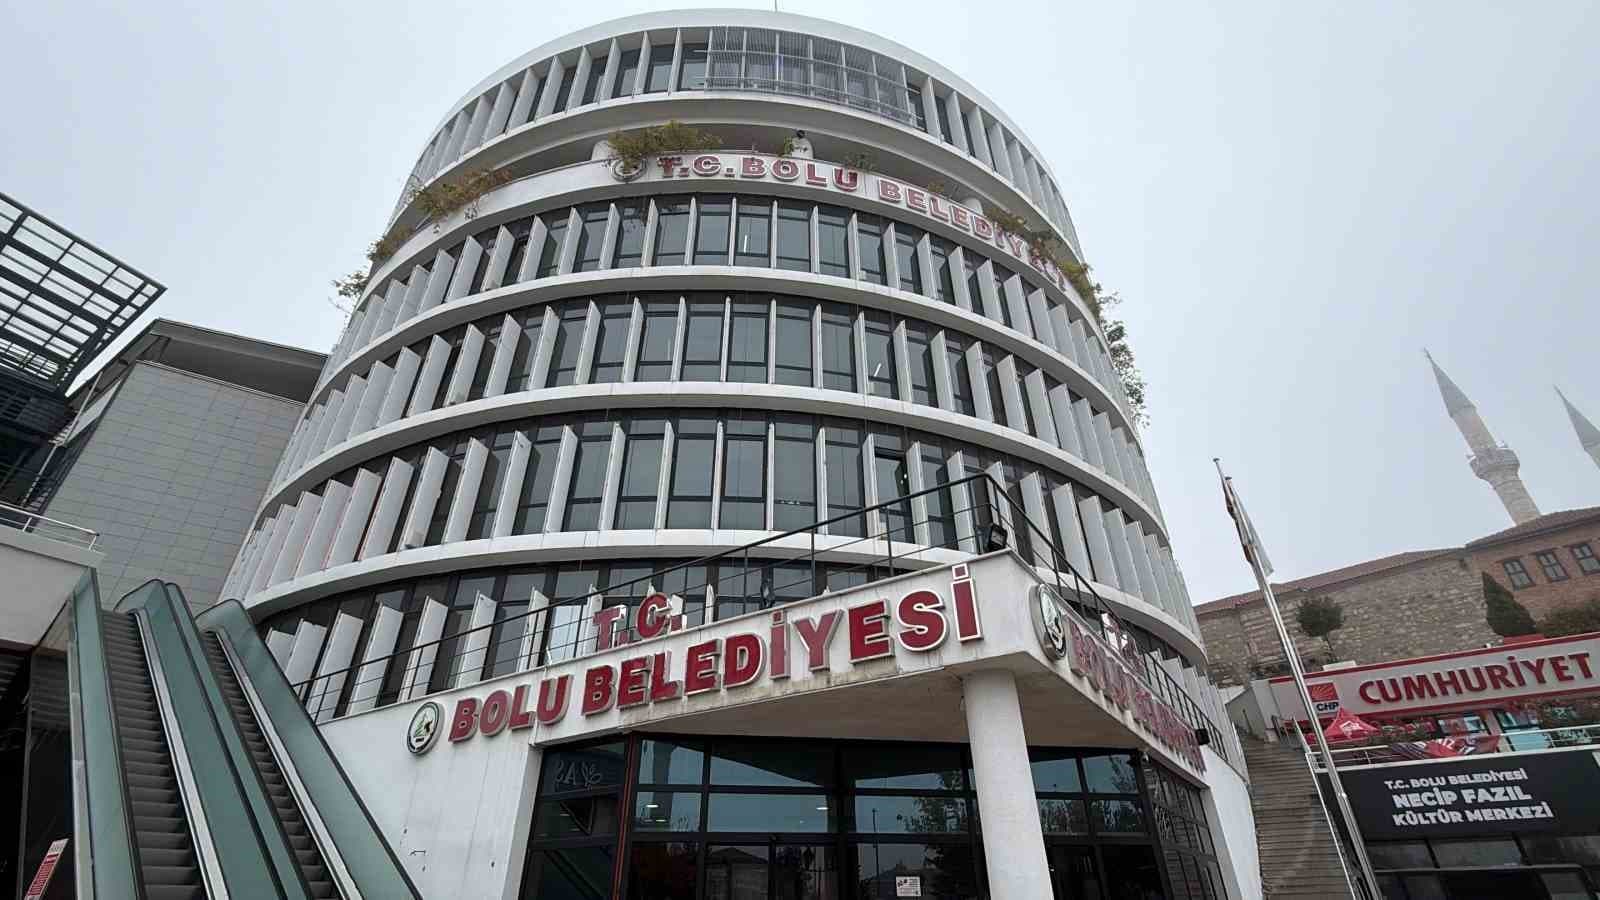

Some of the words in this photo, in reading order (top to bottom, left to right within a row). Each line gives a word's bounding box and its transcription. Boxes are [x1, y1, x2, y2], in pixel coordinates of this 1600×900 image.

[877, 178, 1067, 293] BELEDİY
[448, 674, 577, 743] BOLU
[581, 564, 984, 716] BELEDİYESİ
[1358, 653, 1594, 705] CUMHURİYET
[1316, 701, 1339, 712] CHP
[1384, 780, 1410, 790] T.C.
[1411, 776, 1446, 788] BOLU
[1448, 768, 1528, 785] BELEDİYESİ
[1392, 787, 1458, 809] NECİP
[1461, 785, 1532, 804] FAZIL
[1392, 809, 1464, 826] KÜLTÜR
[1464, 801, 1553, 823] MERKEZİ
